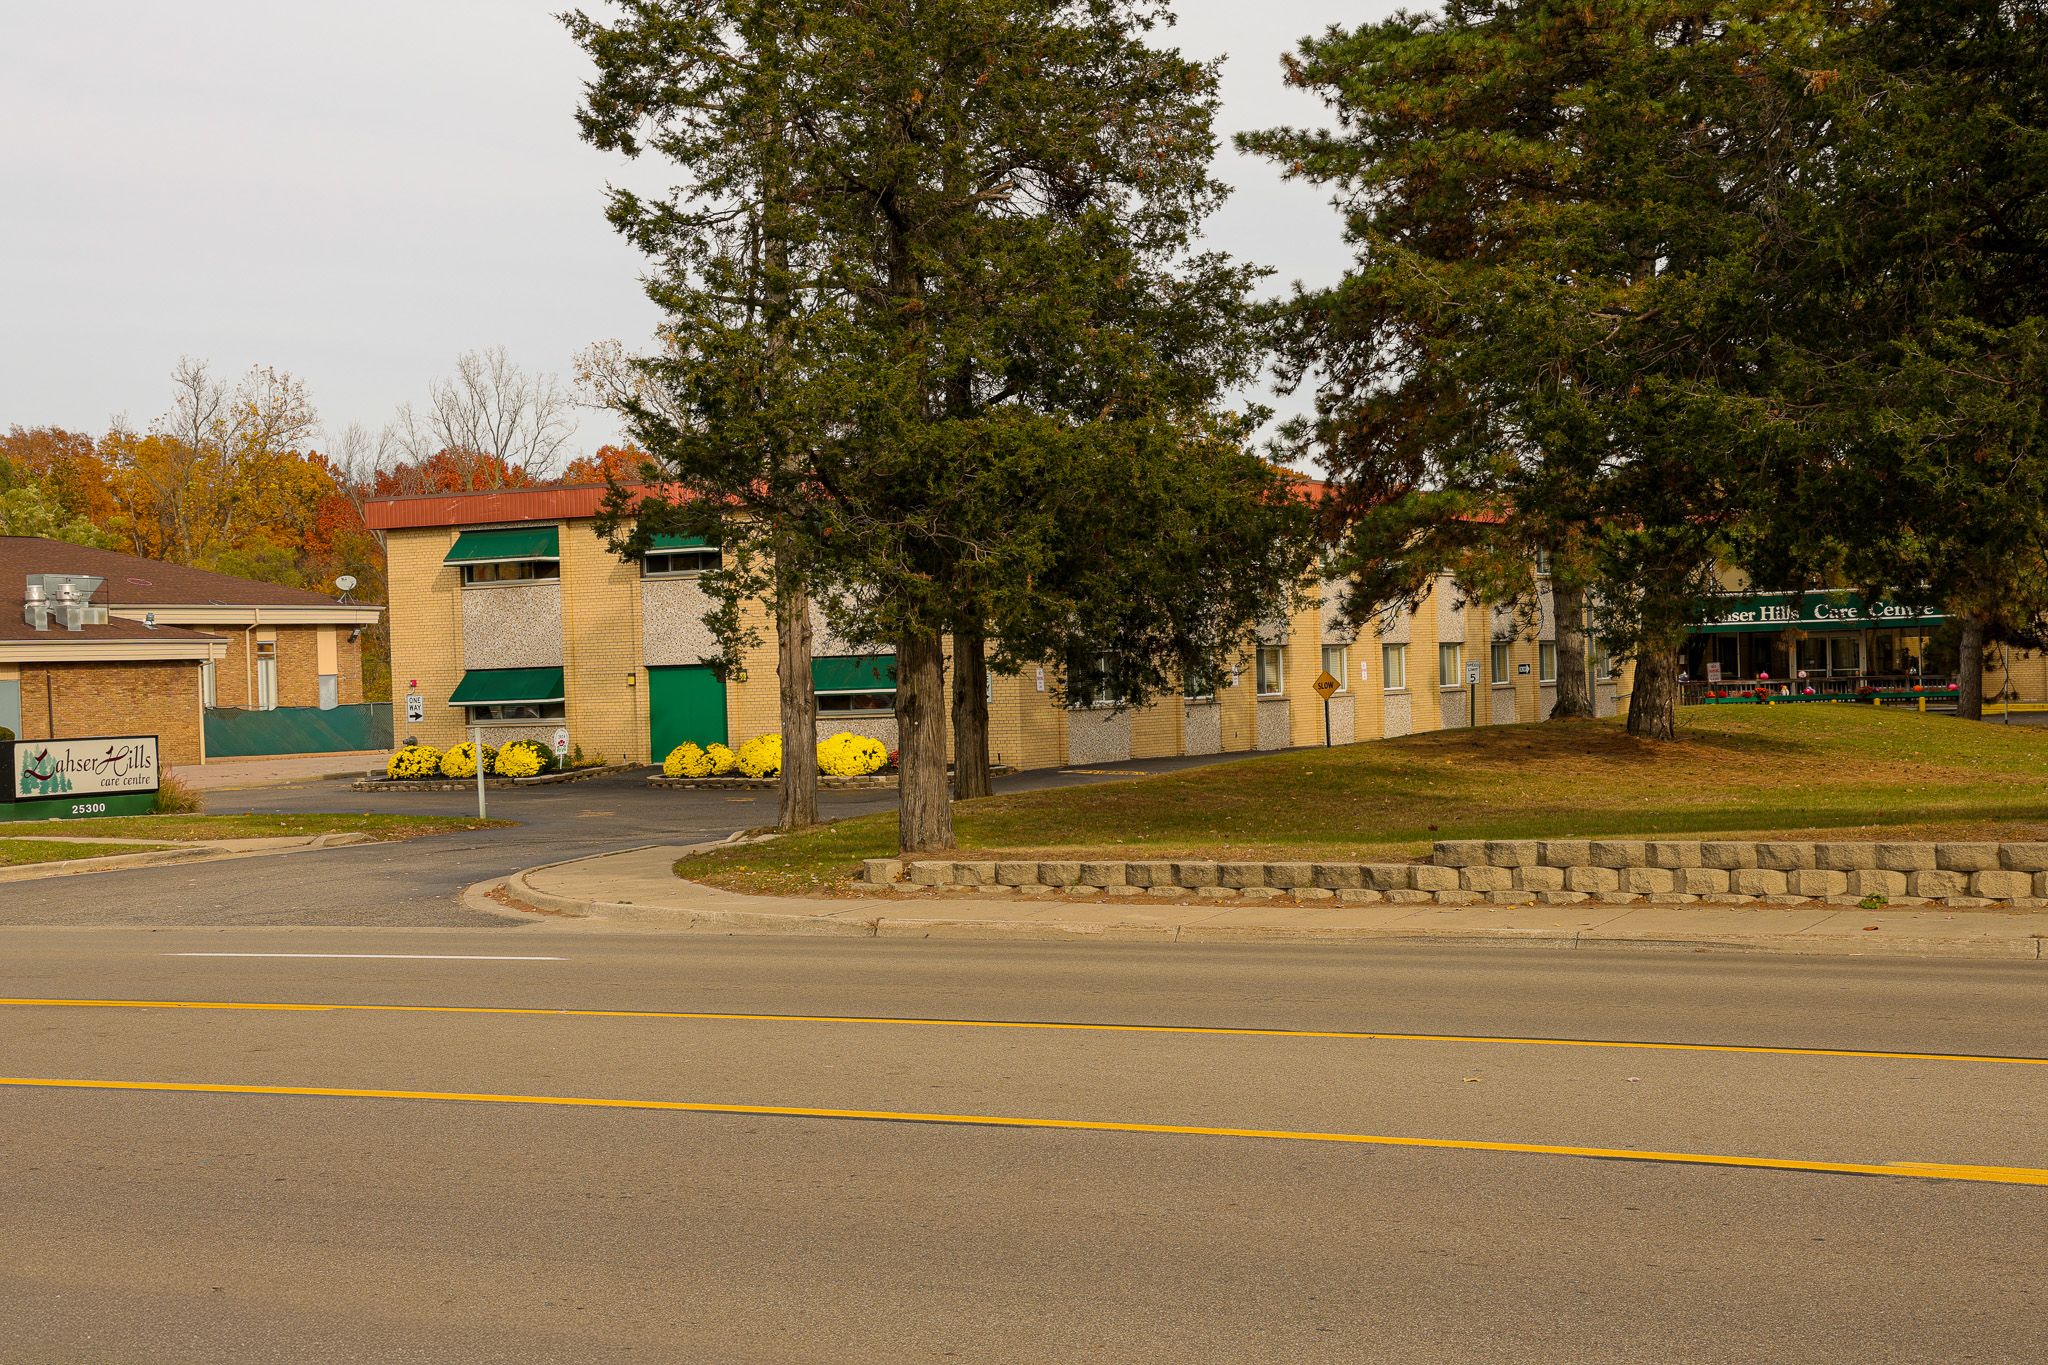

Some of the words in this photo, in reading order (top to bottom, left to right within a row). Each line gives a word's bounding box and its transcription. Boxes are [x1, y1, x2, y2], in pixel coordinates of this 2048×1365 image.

[1759, 604, 1800, 621] Hills
[1813, 603, 1858, 620] Care
[1470, 673, 1476, 683] 5
[1317, 680, 1334, 690] SLOW
[23, 748, 98, 781] Lahser
[95, 744, 152, 777] Hills
[100, 777, 120, 787] care
[123, 773, 151, 786] centre
[71, 803, 106, 814] 25300
